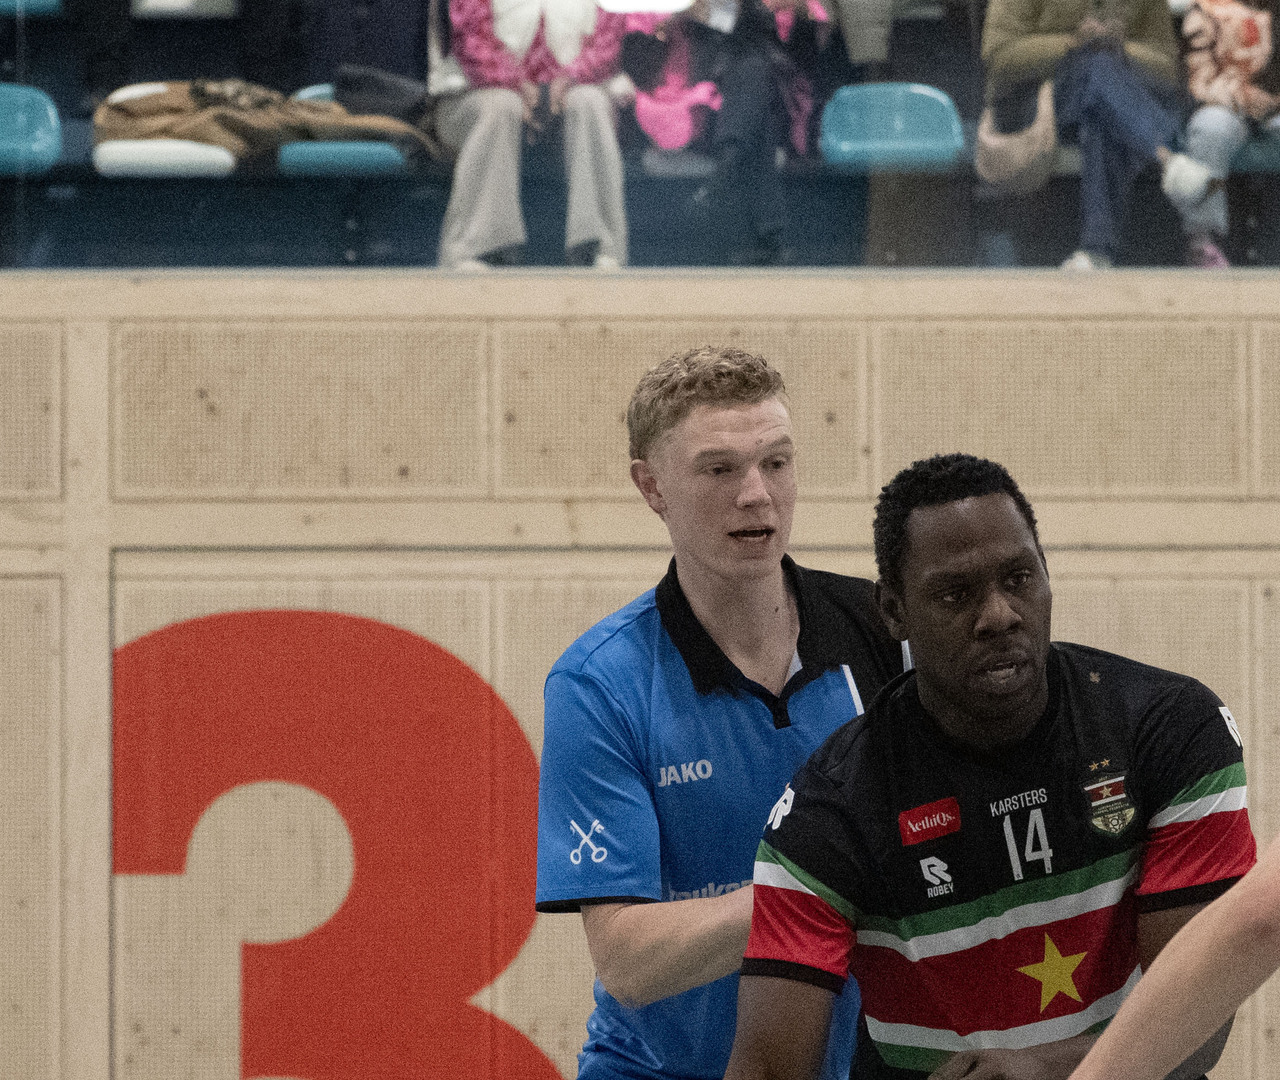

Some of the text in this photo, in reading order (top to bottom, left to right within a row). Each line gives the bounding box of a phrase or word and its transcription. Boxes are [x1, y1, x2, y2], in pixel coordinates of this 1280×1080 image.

[658, 759, 713, 787] JAKO
[989, 788, 1048, 817] KARSTERS
[1003, 808, 1053, 881] 14
[927, 882, 954, 898] ROBEY
